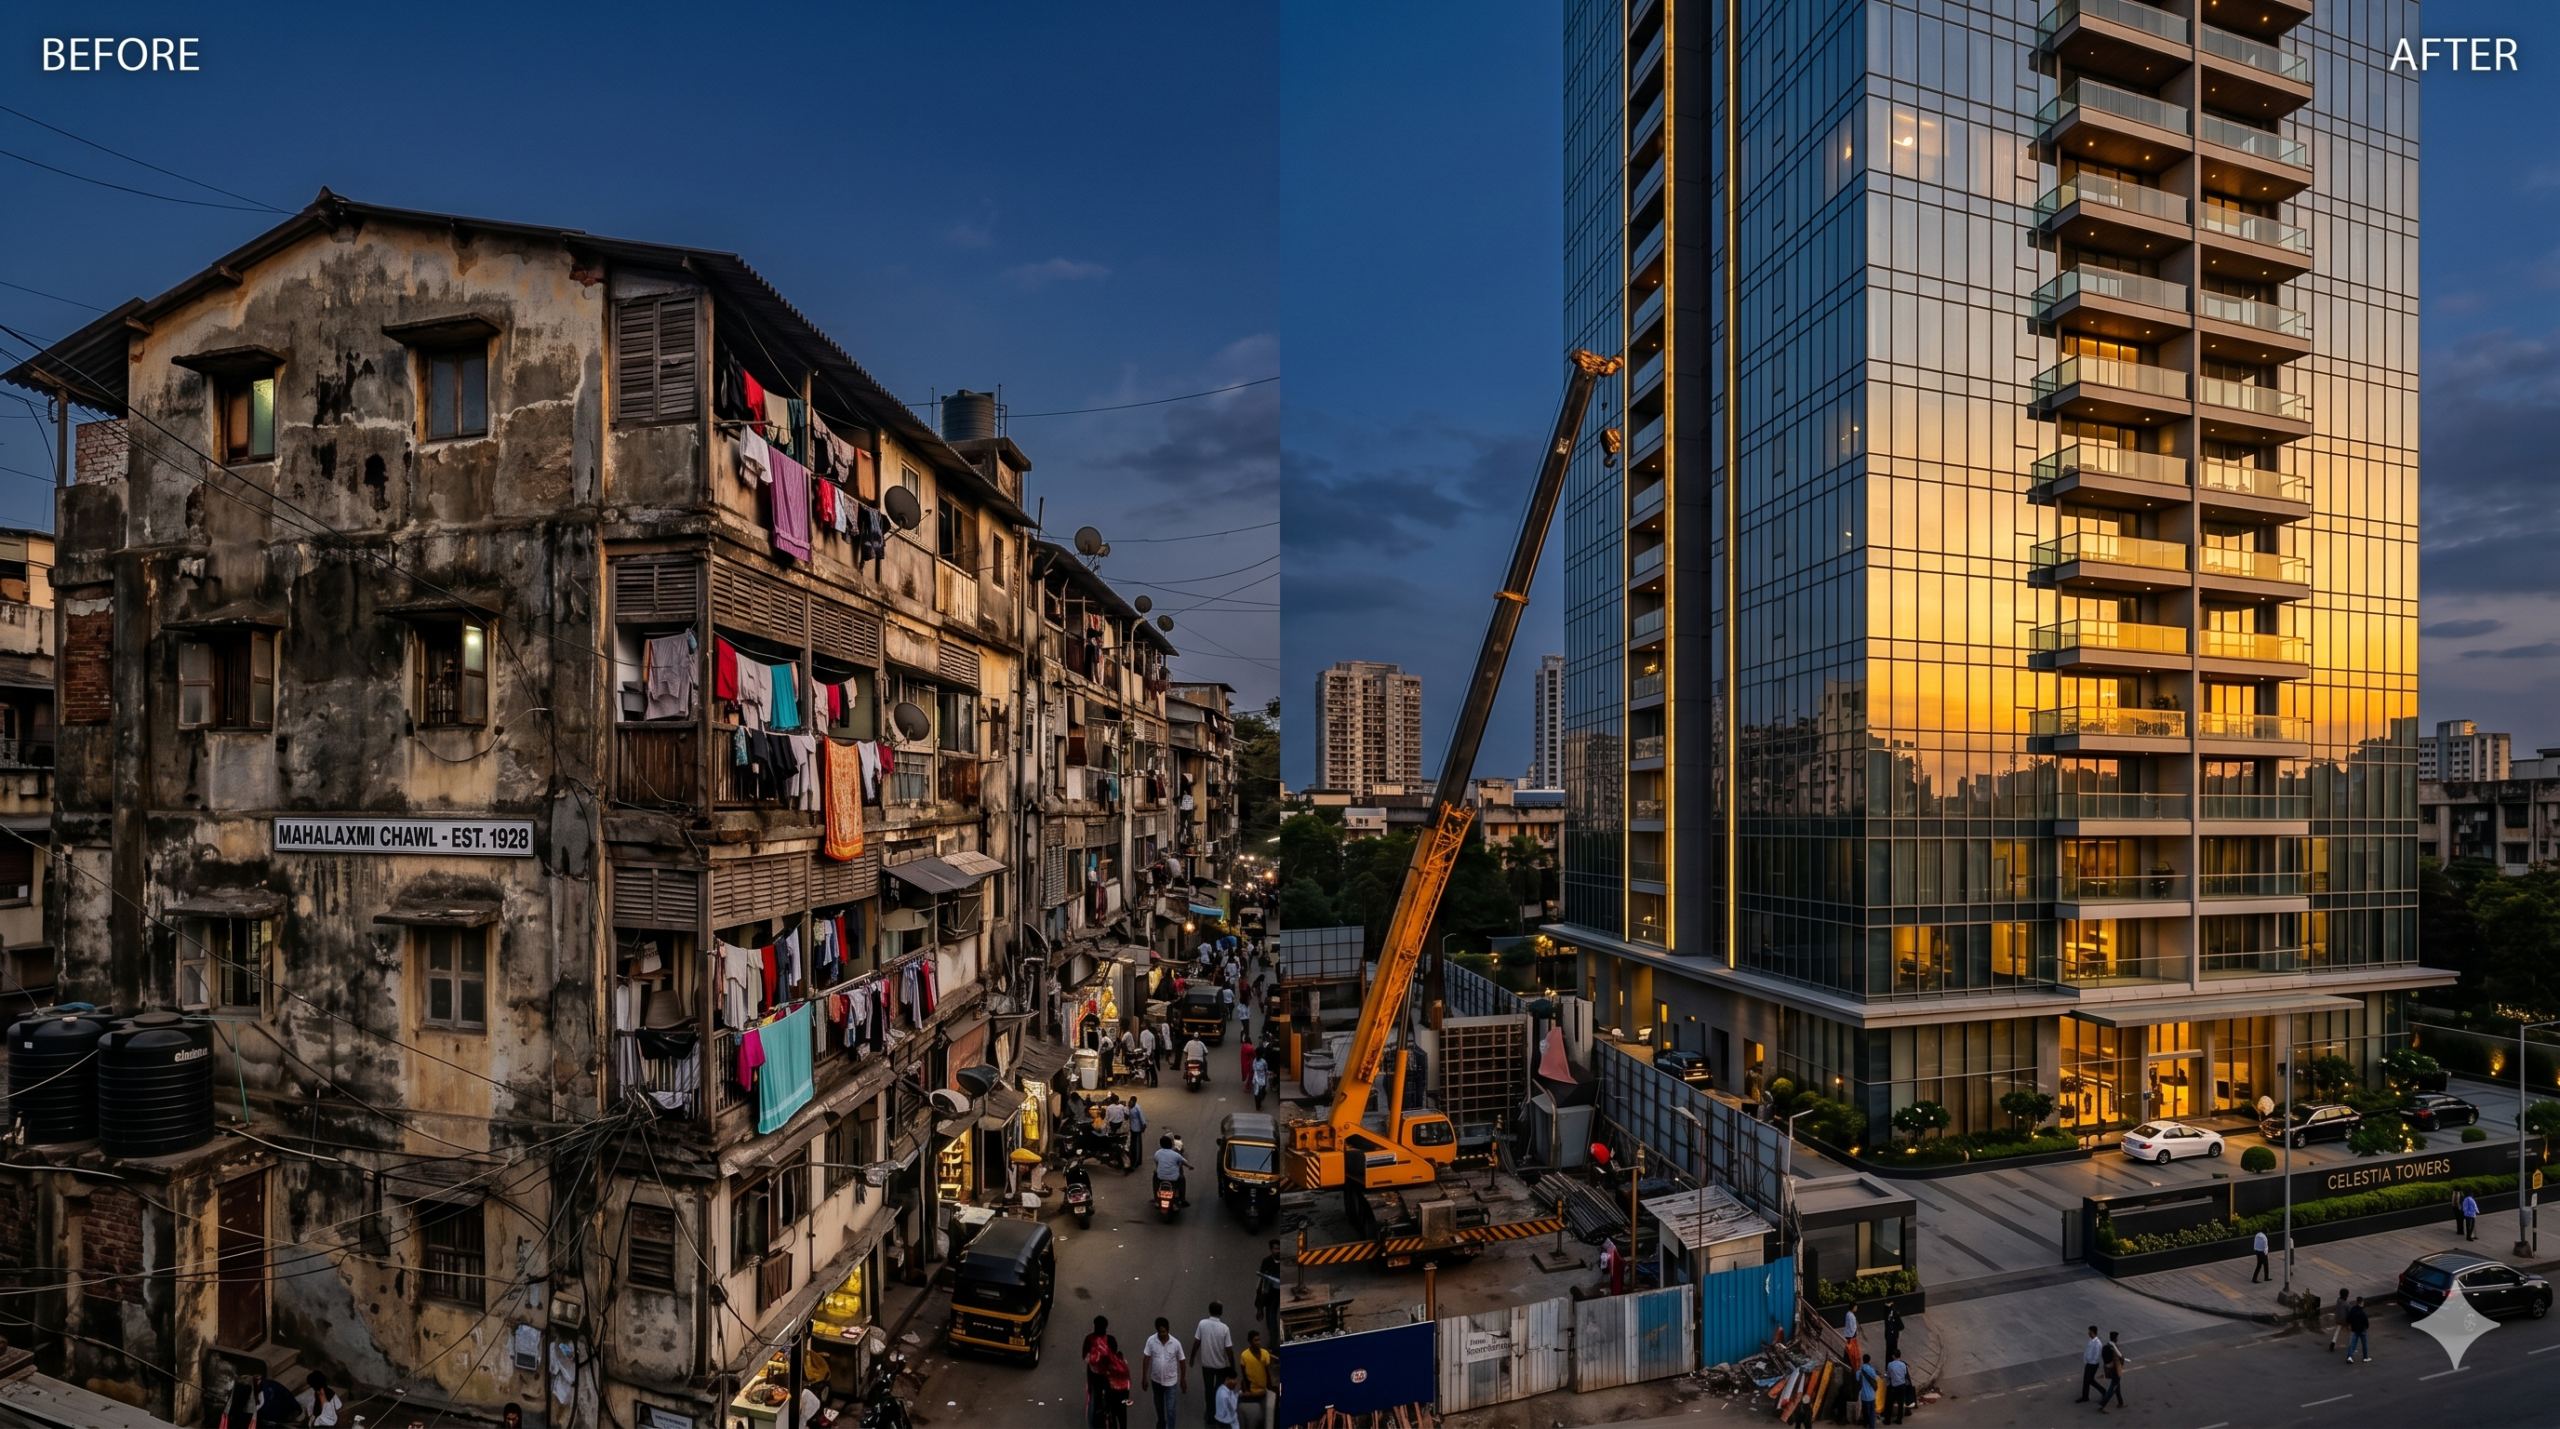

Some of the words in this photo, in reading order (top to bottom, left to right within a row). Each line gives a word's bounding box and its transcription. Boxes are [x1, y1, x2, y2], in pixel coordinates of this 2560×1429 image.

[278, 824, 376, 847] MAHALAXMI
[379, 825, 438, 848] CHAWL
[451, 827, 487, 849] EST.
[489, 827, 529, 850] 1928
[2327, 1167, 2392, 1190] CELESTIA
[2395, 1158, 2451, 1180] TOWERS
